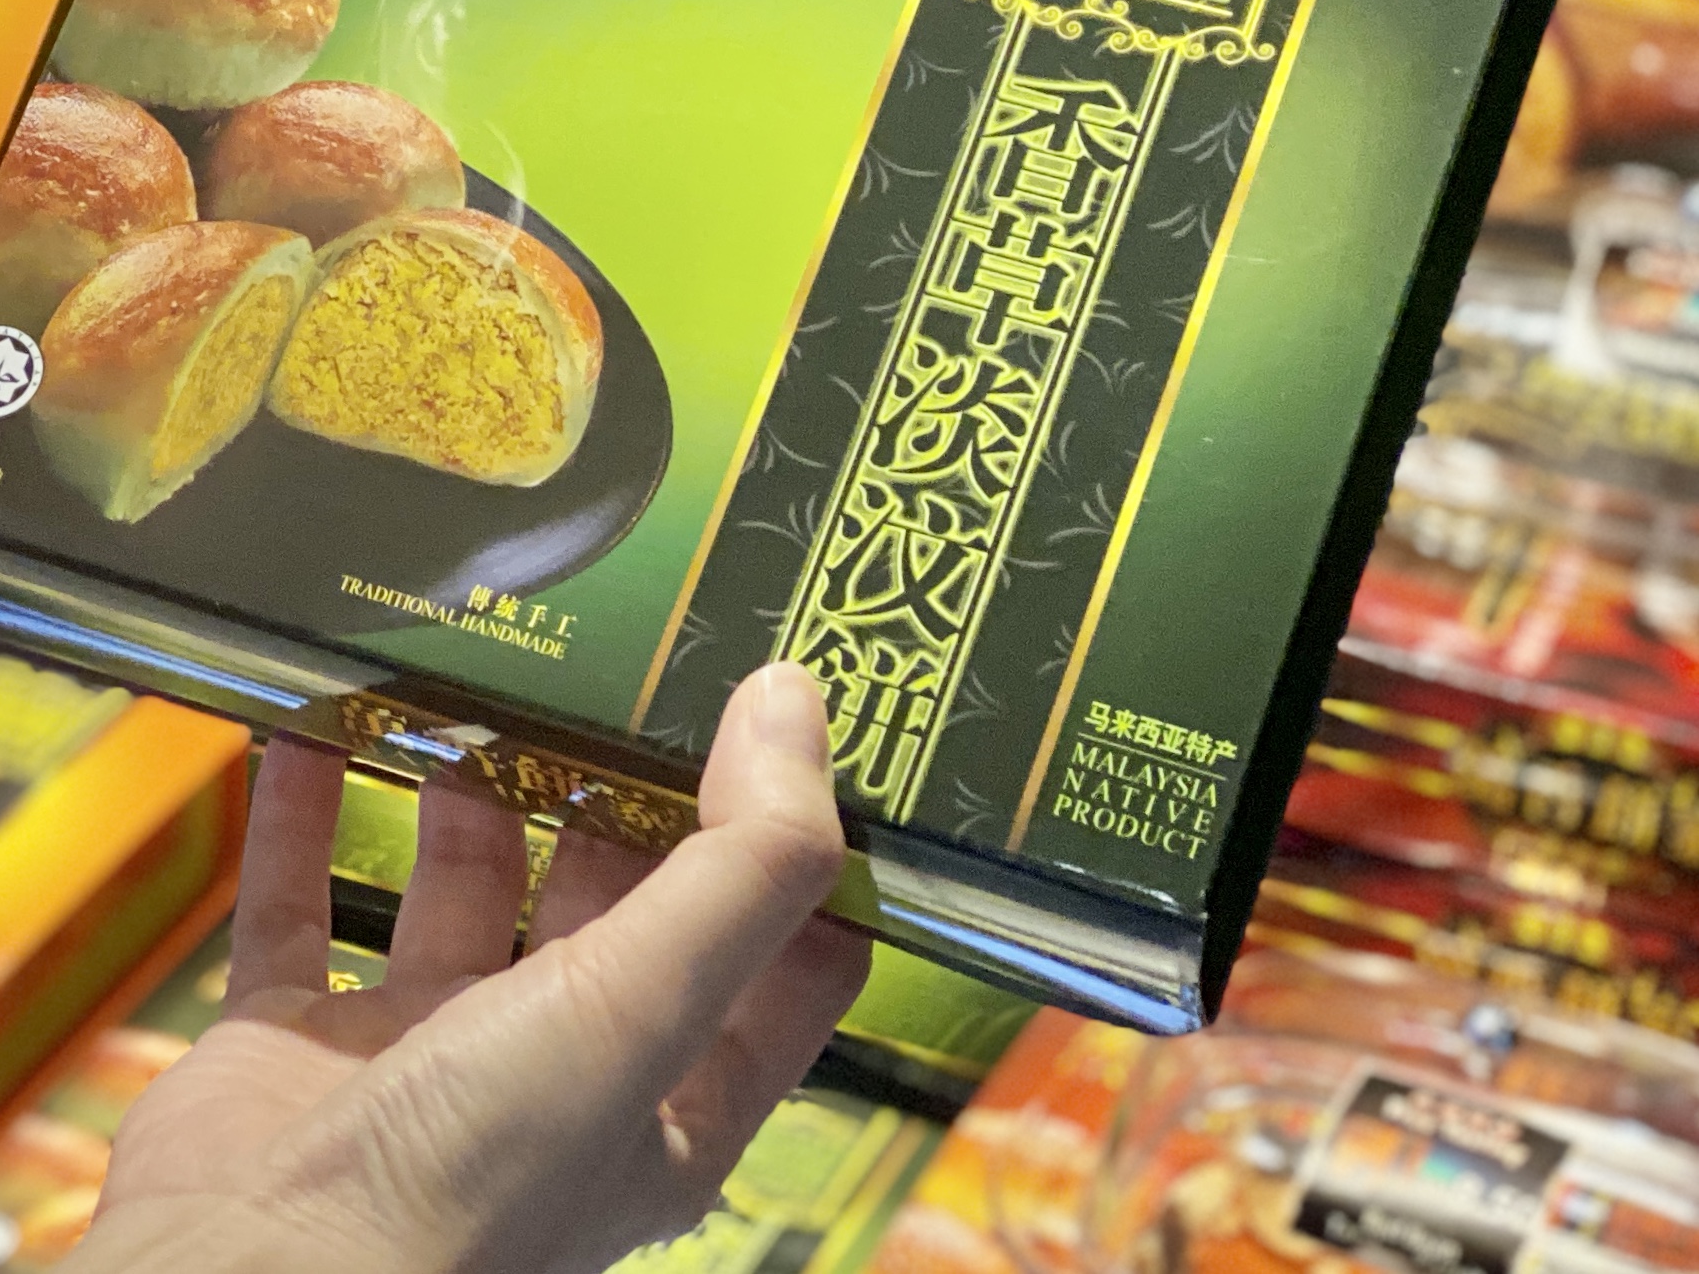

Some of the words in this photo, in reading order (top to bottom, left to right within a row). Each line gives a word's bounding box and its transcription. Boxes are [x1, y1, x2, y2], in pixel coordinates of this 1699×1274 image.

[340, 574, 458, 626] TRADITIONAL
[459, 612, 567, 660] HANDMADE
[1084, 700, 1238, 766] 马来西亚特产
[1062, 767, 1216, 834] NATIVE
[1071, 741, 1218, 809] MALAYSIA
[1052, 793, 1208, 860] PRODUCT
